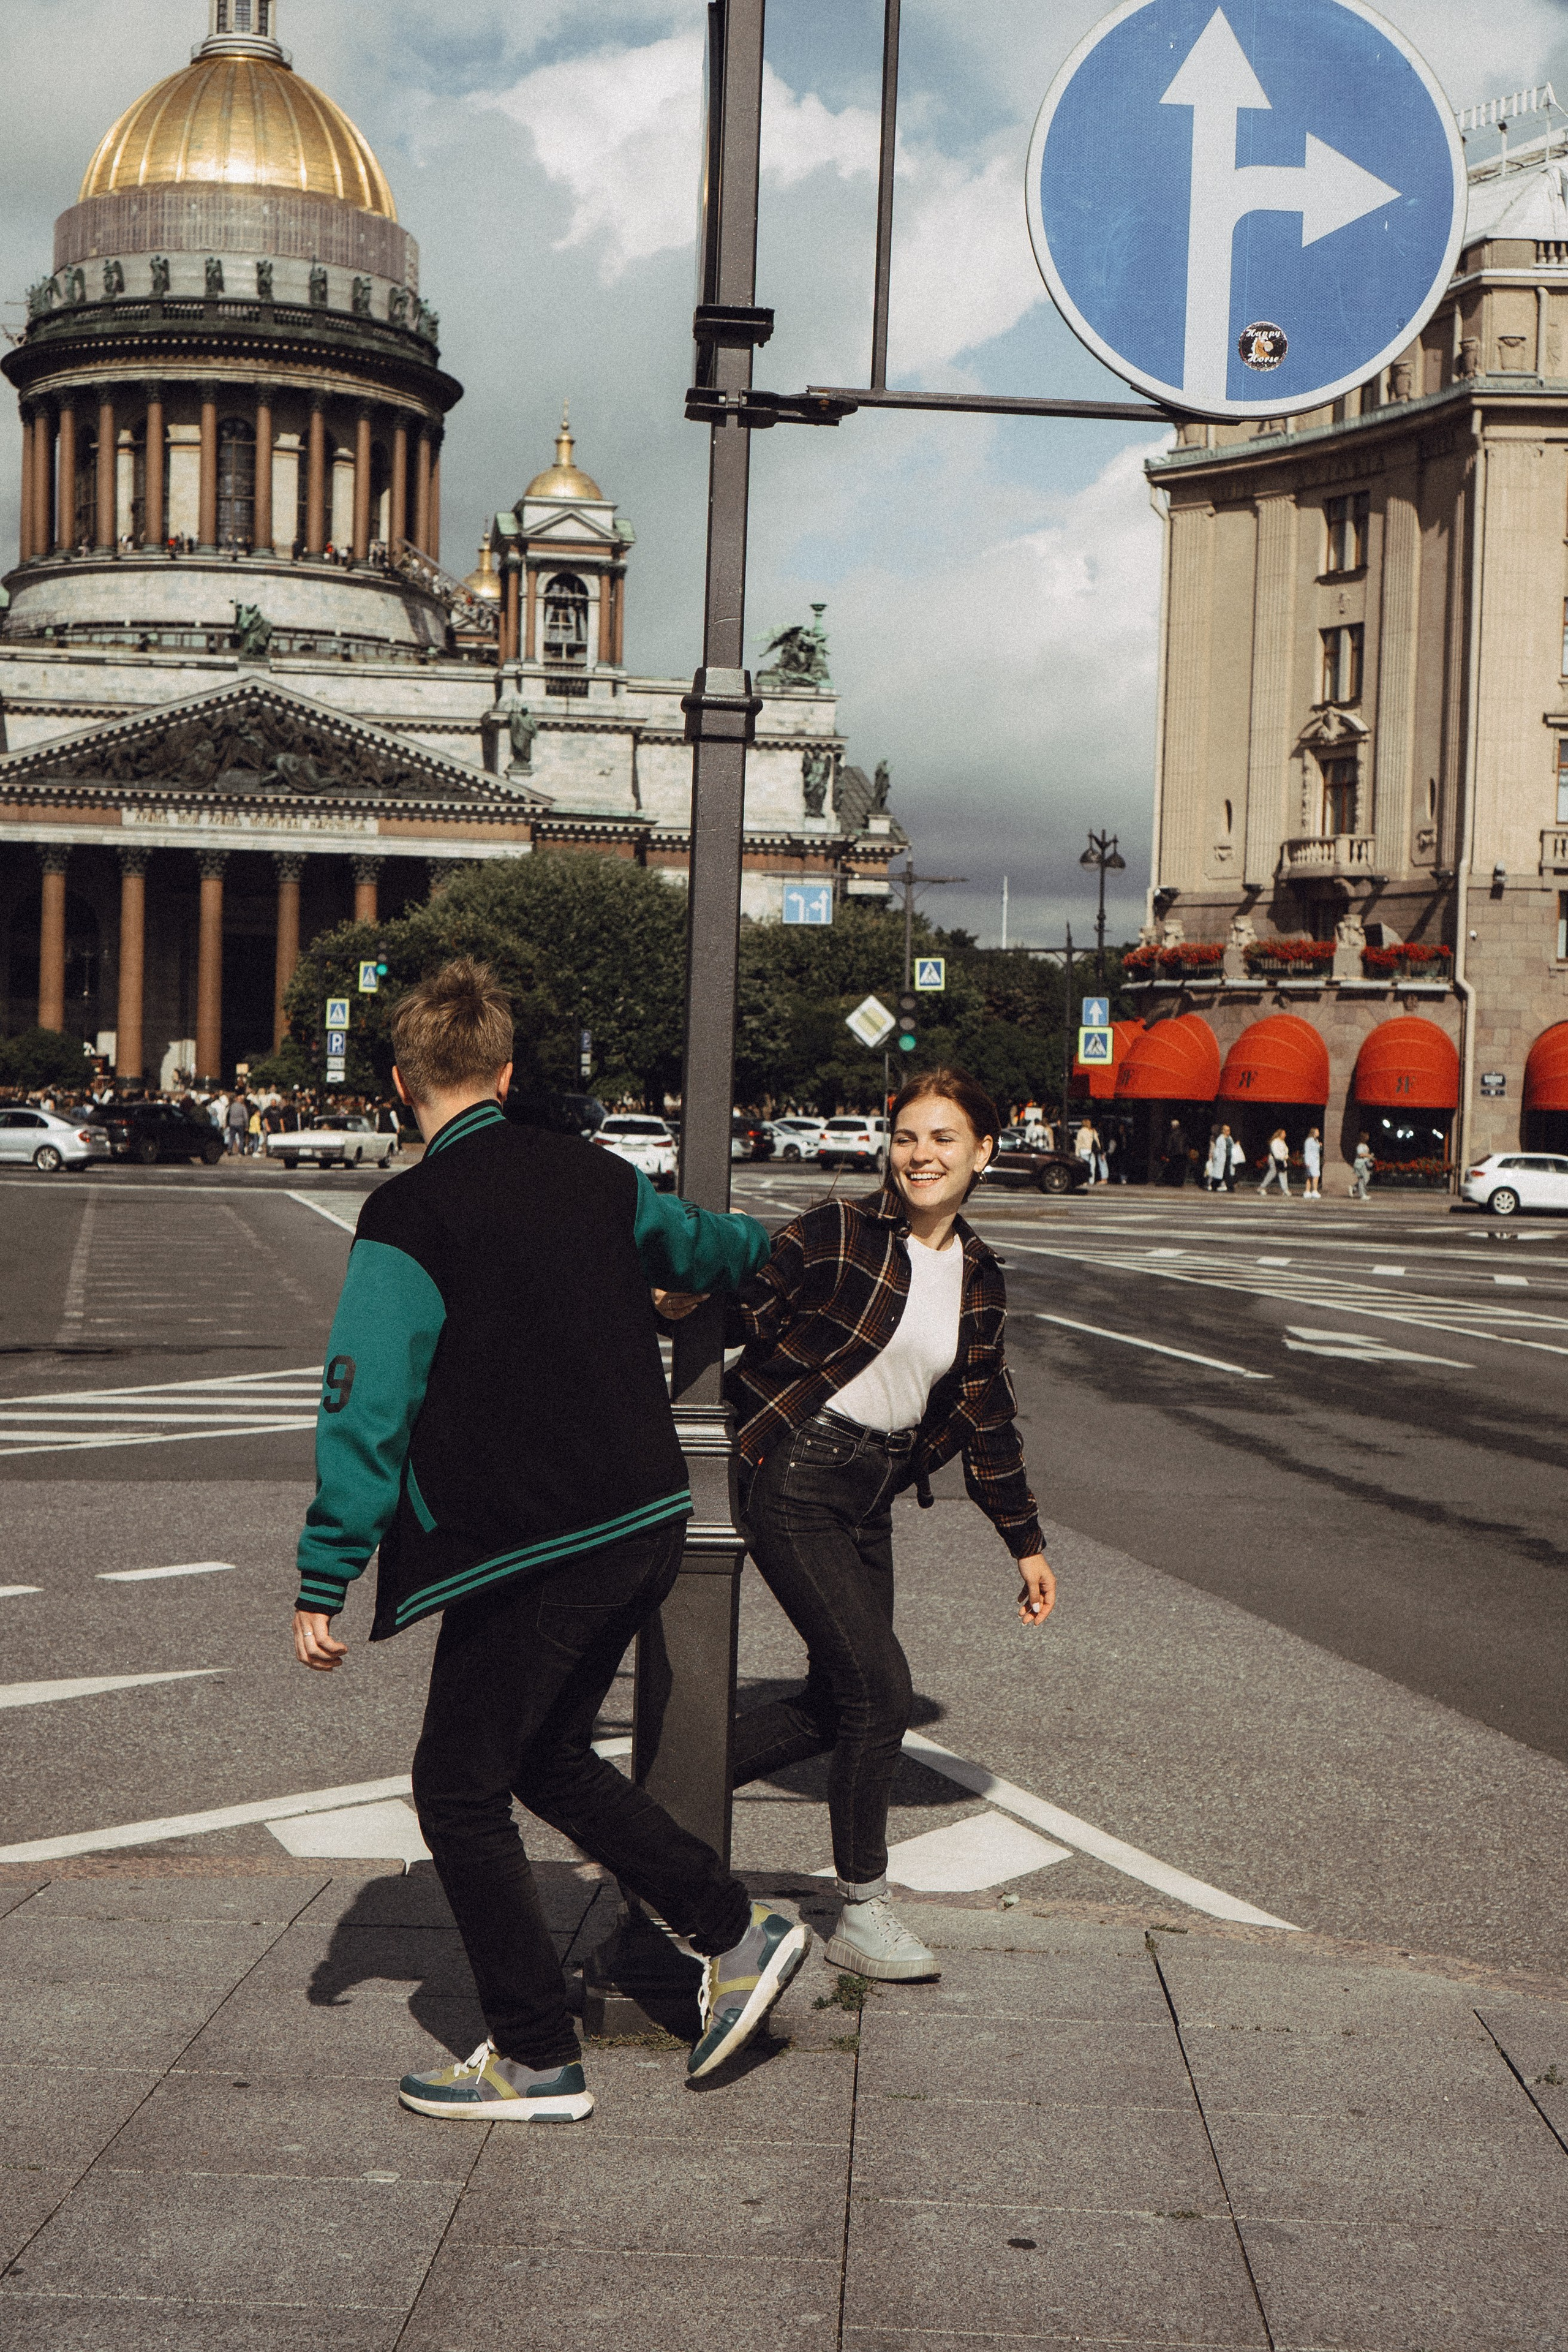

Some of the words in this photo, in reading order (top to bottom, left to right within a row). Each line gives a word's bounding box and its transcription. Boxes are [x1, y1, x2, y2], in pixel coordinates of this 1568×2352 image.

[1246, 329, 1281, 337] Happy
[1247, 353, 1279, 363] Horse
[323, 1355, 356, 1414] 9
